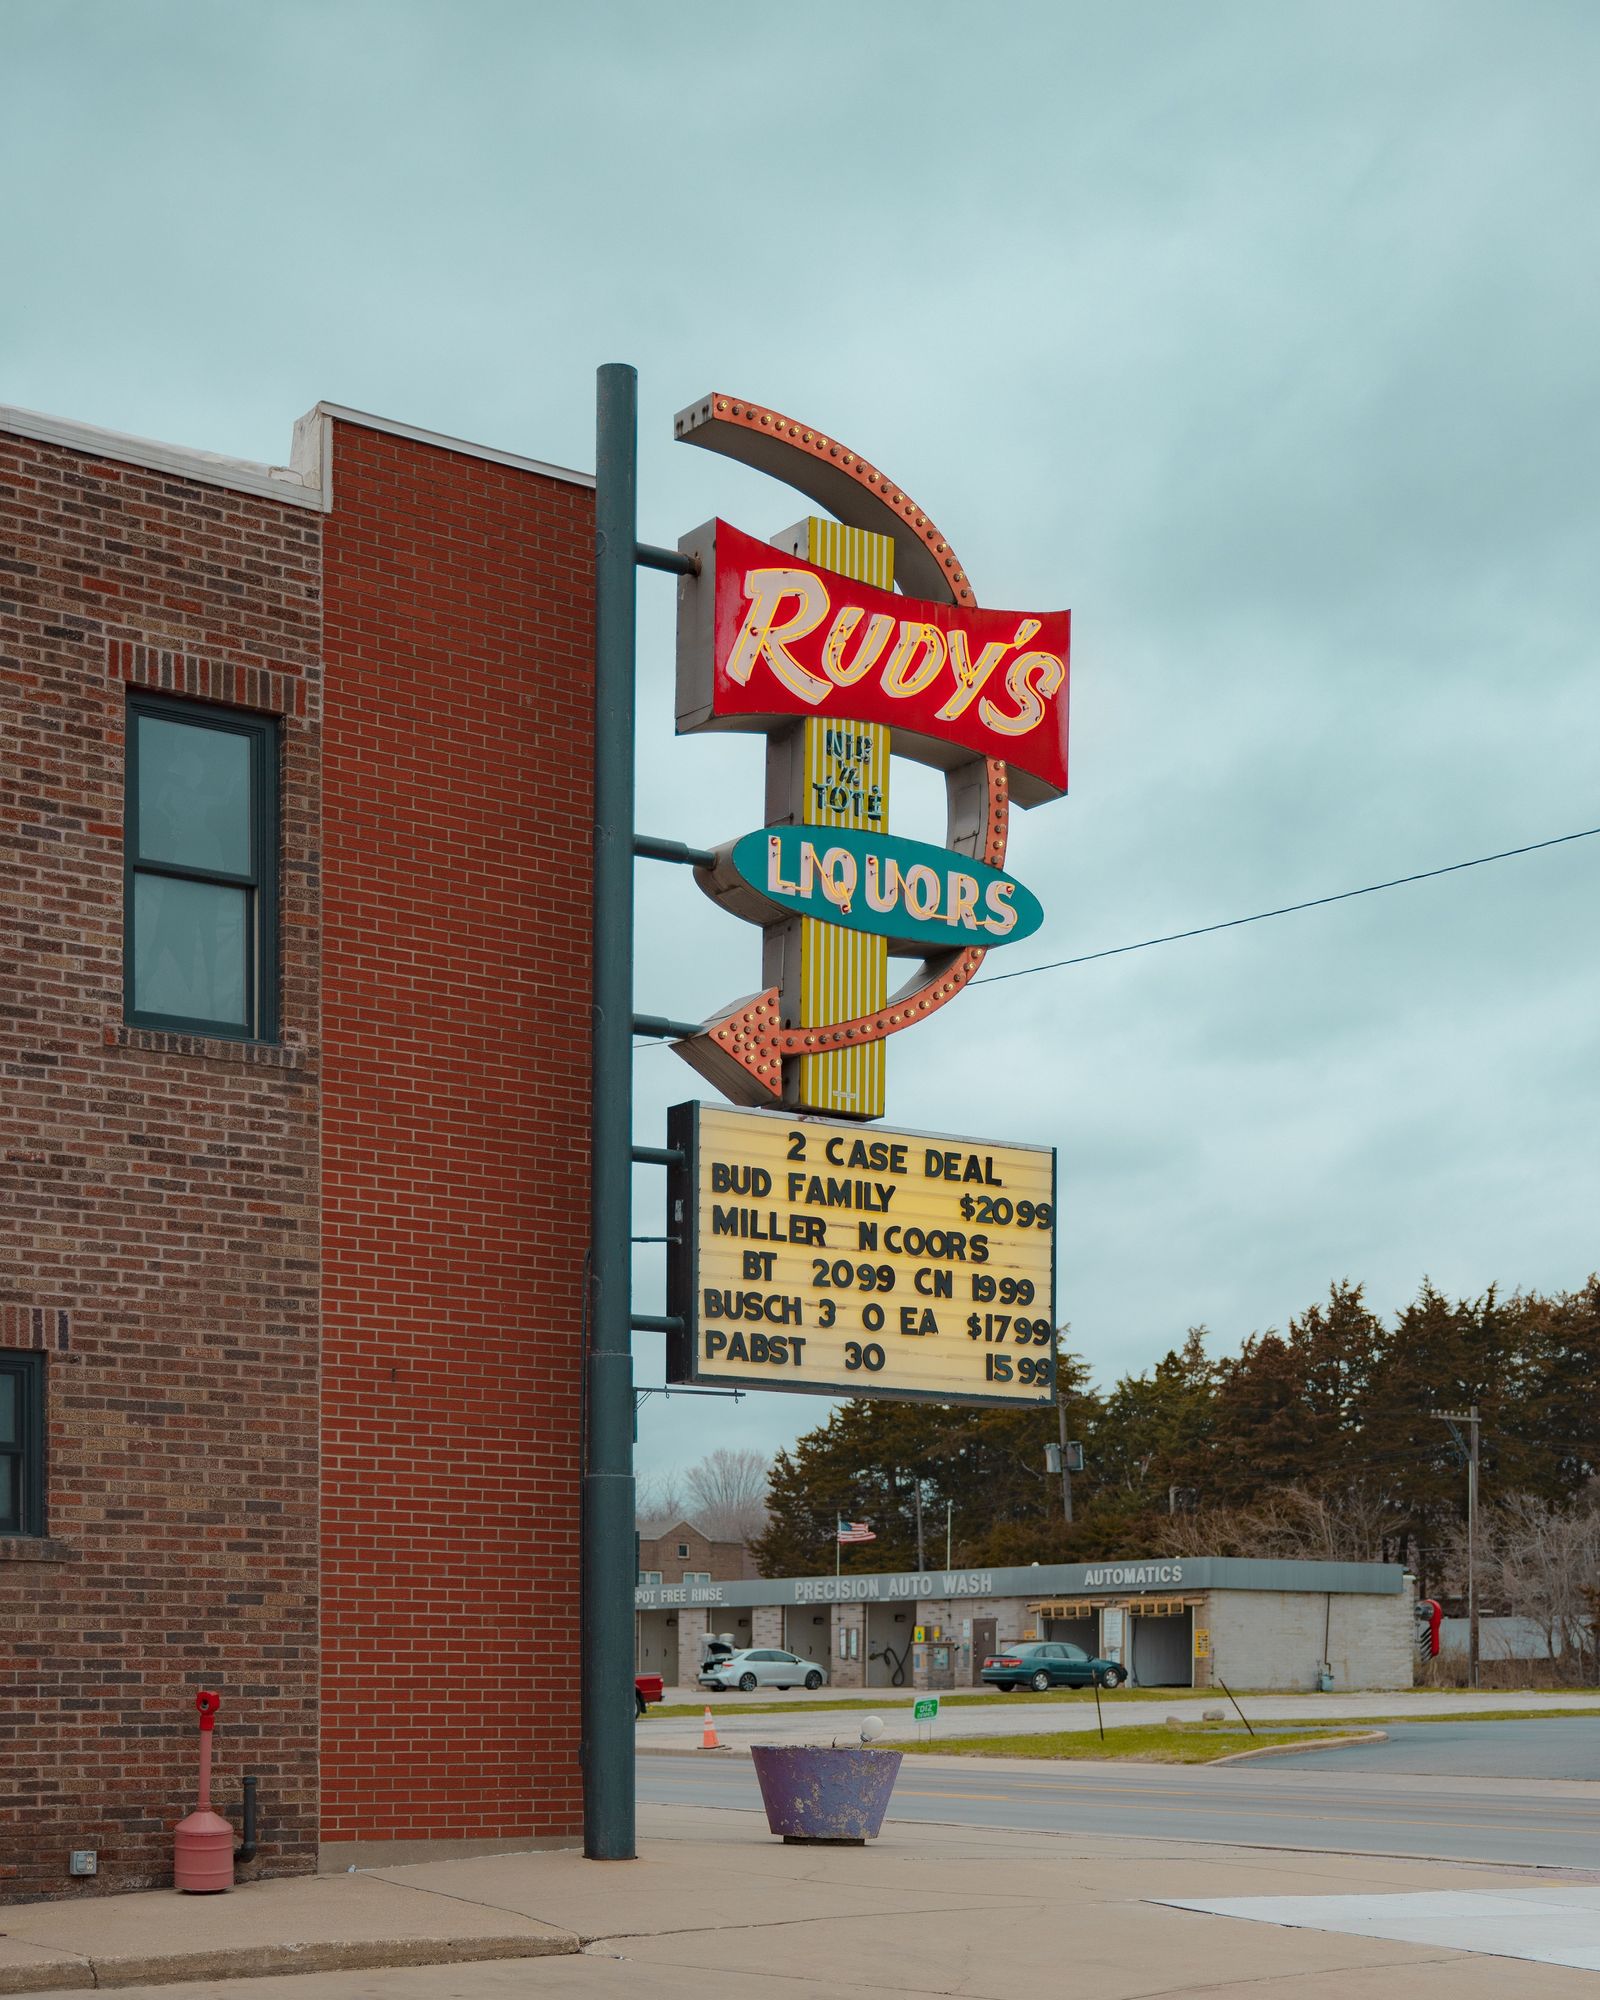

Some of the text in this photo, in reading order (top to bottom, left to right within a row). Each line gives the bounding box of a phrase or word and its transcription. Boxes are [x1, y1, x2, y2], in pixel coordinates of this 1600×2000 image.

[725, 568, 1066, 737] RUDY'S
[826, 729, 873, 763] NIP
[812, 782, 883, 821] TOTE
[767, 834, 1018, 936] LIQUORS
[787, 1132, 1002, 1186] 2 CASE DEAL
[712, 1163, 1052, 1229] BUD FAMILY $2099
[712, 1205, 826, 1246] MILLER
[743, 1250, 1034, 1306] BT 2099 CN 1999
[704, 1288, 802, 1325] BUSCH
[900, 1307, 938, 1335] EA
[967, 1313, 1050, 1346] $1799
[706, 1330, 1051, 1384] PABST 30 1599
[635, 1587, 724, 1604] POT FREE RINSE
[794, 1573, 992, 1601] PRECISION AUTO WASH
[1084, 1565, 1183, 1587] AUTOMATICS
